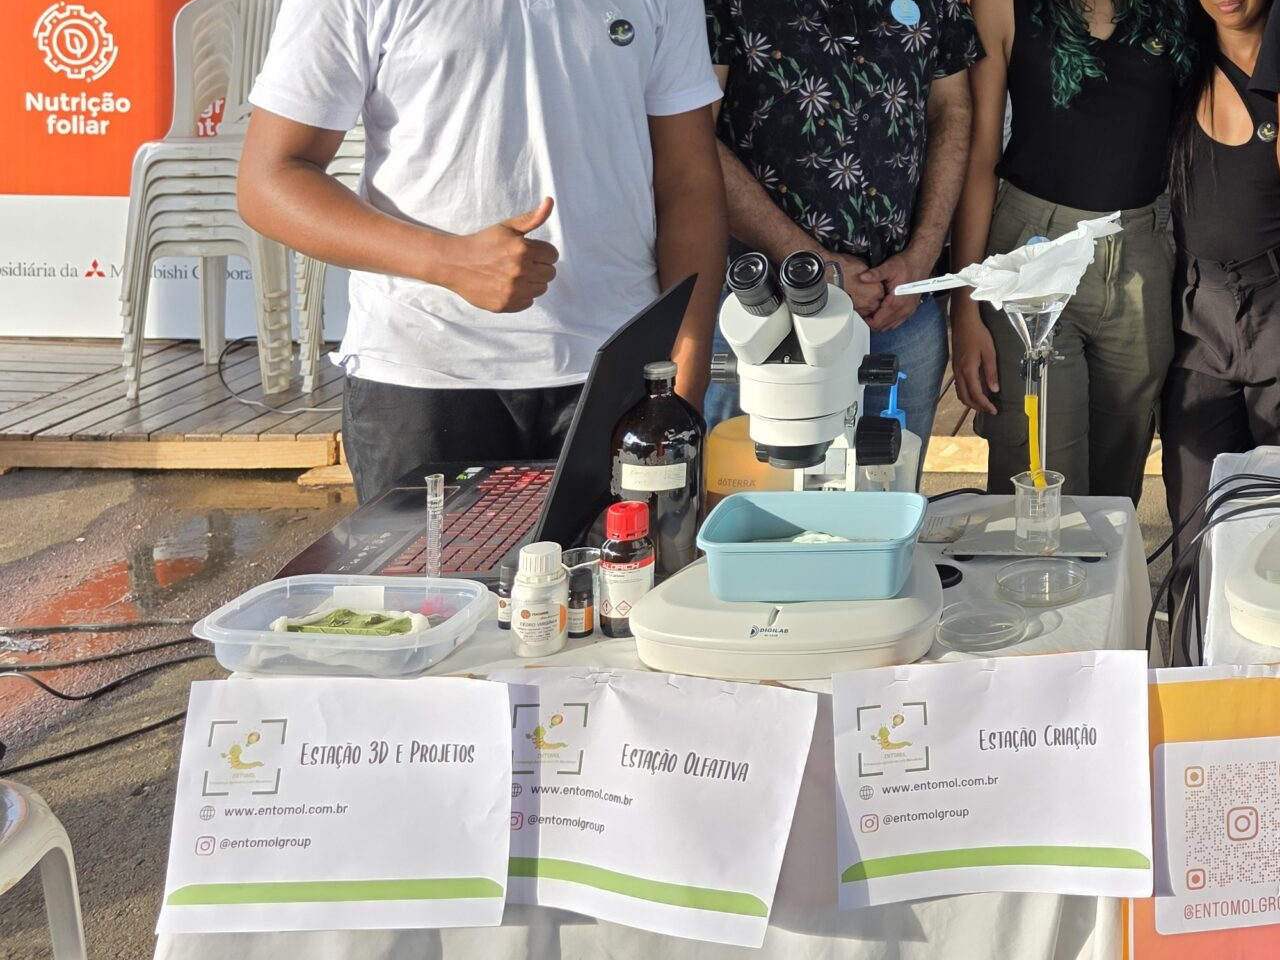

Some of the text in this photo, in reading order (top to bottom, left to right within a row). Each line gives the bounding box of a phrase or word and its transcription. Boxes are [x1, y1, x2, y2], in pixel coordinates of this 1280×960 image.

[25, 91, 131, 114] Nutrição
[47, 114, 109, 136] foliar
[0, 261, 56, 277] sidiária
[60, 264, 78, 277] da
[368, 742, 389, 765] 3D
[530, 783, 633, 807] www.entomol.com.br
[882, 775, 999, 795] www.entomol.com.br
[224, 803, 348, 817] www.entomol.com.br
[882, 806, 970, 826] @entomolgroup
[527, 813, 605, 835] @entomolgroup
[219, 836, 312, 851] @entomolgroup
